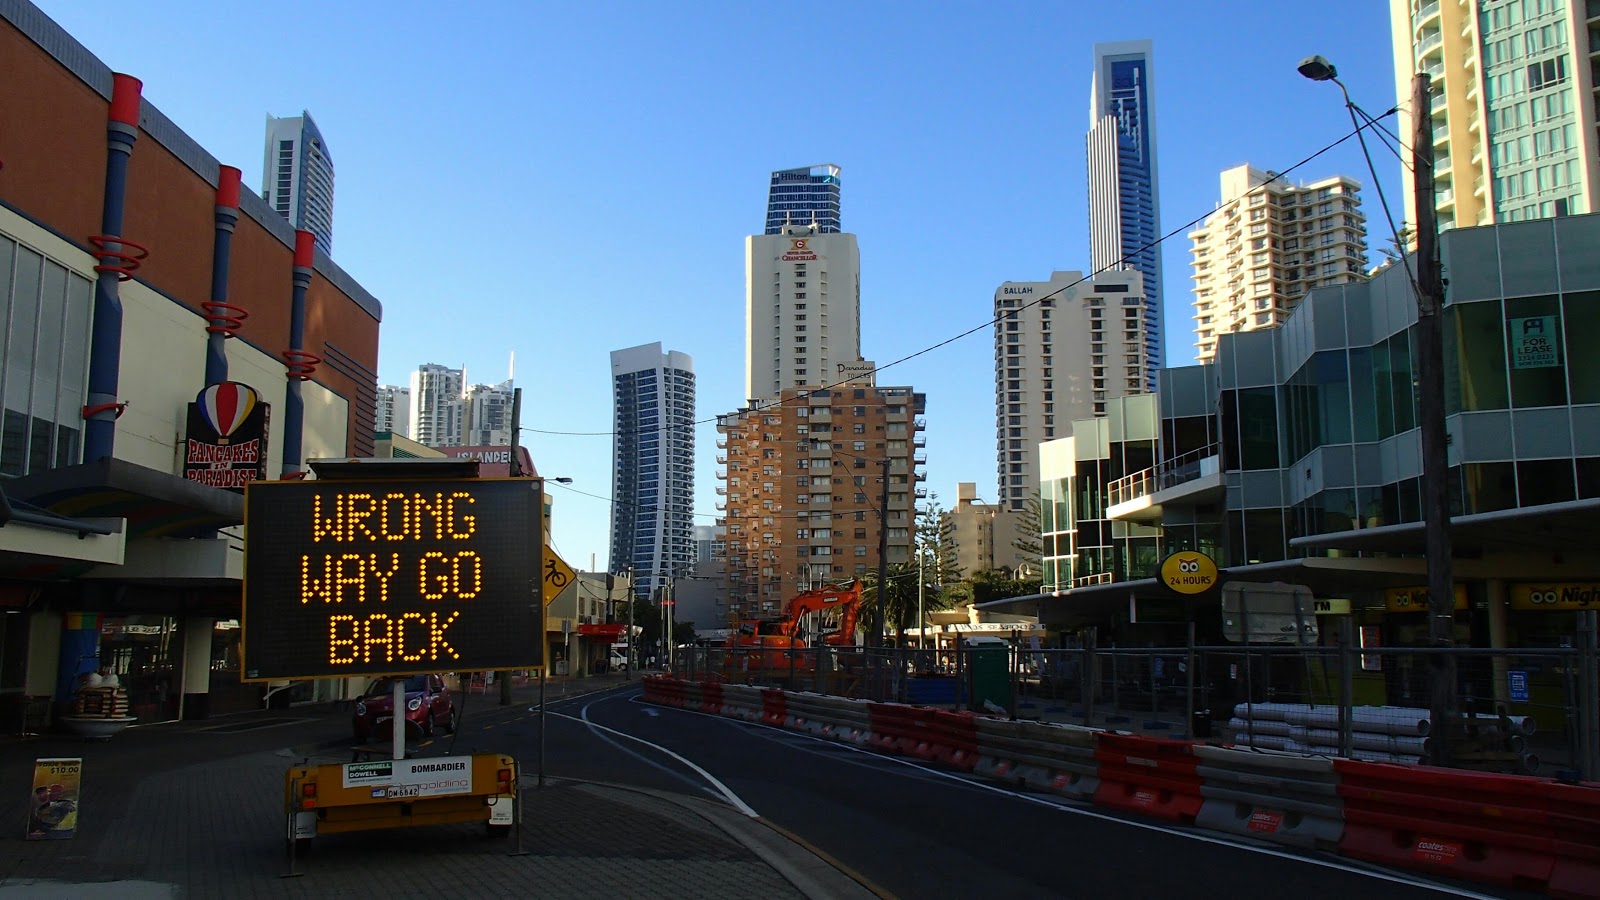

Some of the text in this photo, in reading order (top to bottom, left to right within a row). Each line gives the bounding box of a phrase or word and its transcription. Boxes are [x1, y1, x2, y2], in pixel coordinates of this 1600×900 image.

[1523, 338, 1546, 346] FOR
[1517, 345, 1552, 354] LEASE
[187, 438, 259, 464] PANCAKES
[457, 451, 511, 463] ISANDE
[215, 461, 228, 469] IN
[187, 468, 257, 488] PARADISE
[313, 492, 475, 542] WRONG
[301, 551, 481, 604] WAY GO
[1170, 576, 1211, 585] 24 HOURS
[1314, 601, 1330, 611] TM
[330, 611, 460, 664] BACK
[411, 762, 466, 773] BOMBARDIER
